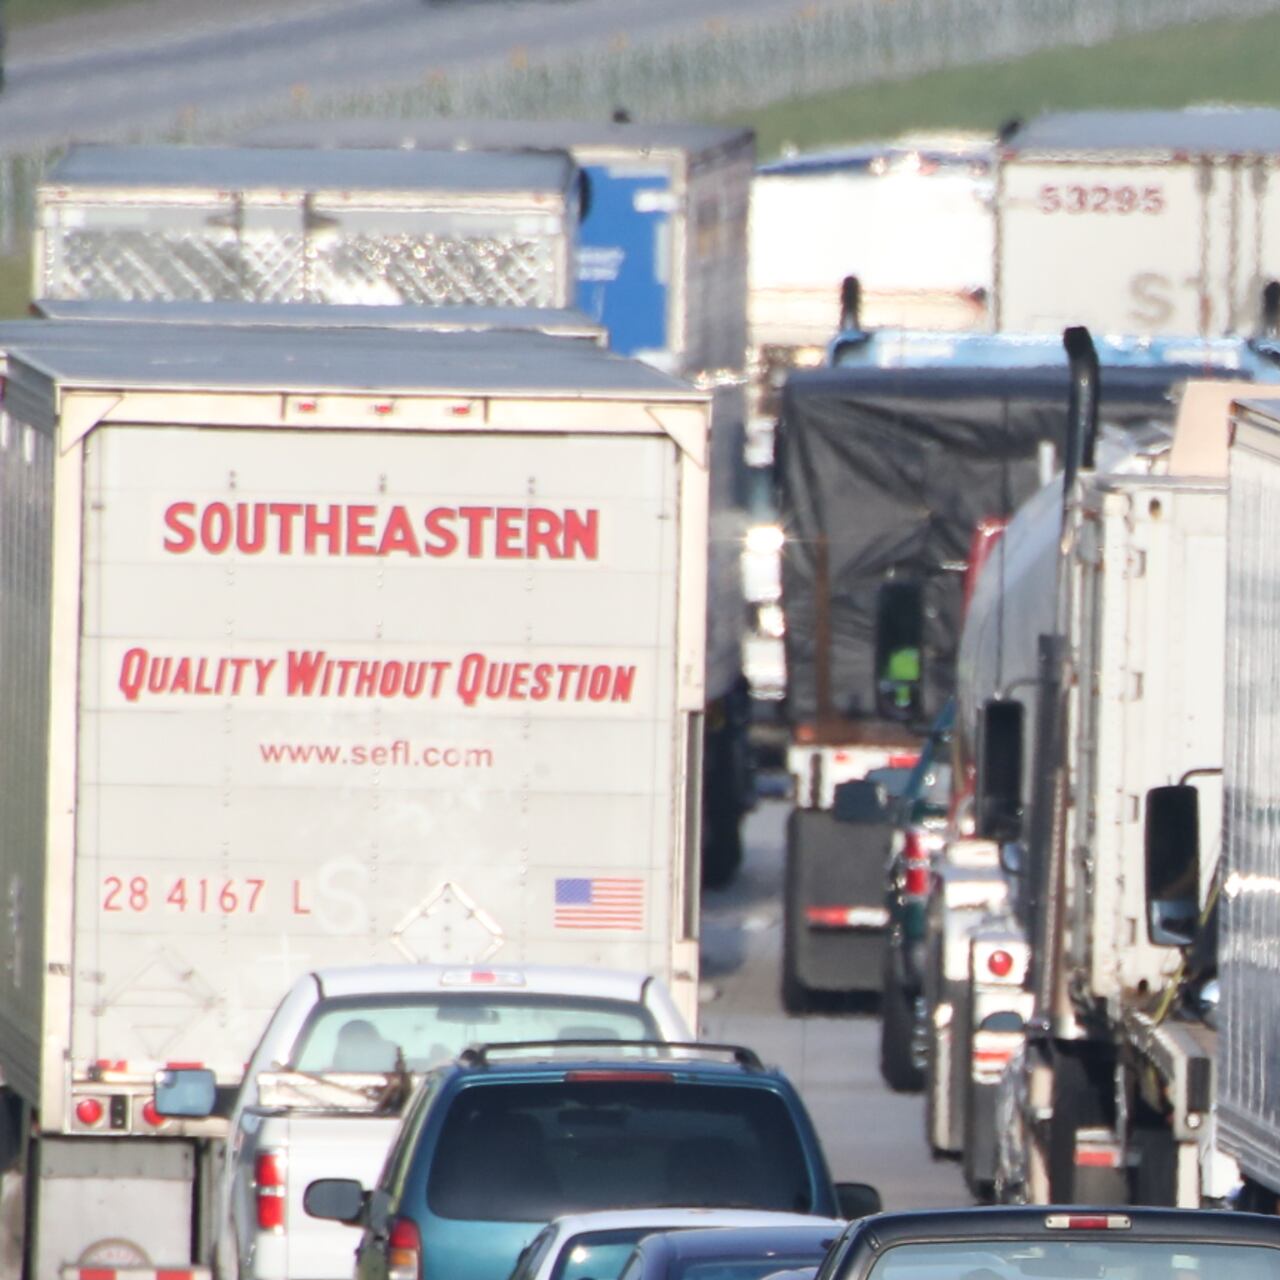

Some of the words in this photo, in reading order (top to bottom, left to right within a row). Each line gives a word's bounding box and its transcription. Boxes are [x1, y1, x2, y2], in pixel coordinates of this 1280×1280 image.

[1040, 186, 1164, 215] 53295
[163, 501, 599, 560] SOUTHEASTERN
[118, 648, 275, 702] QUALITY
[287, 650, 451, 697] WITHOUT
[456, 652, 637, 706] QUESTION
[259, 741, 493, 768] www.sefl.com
